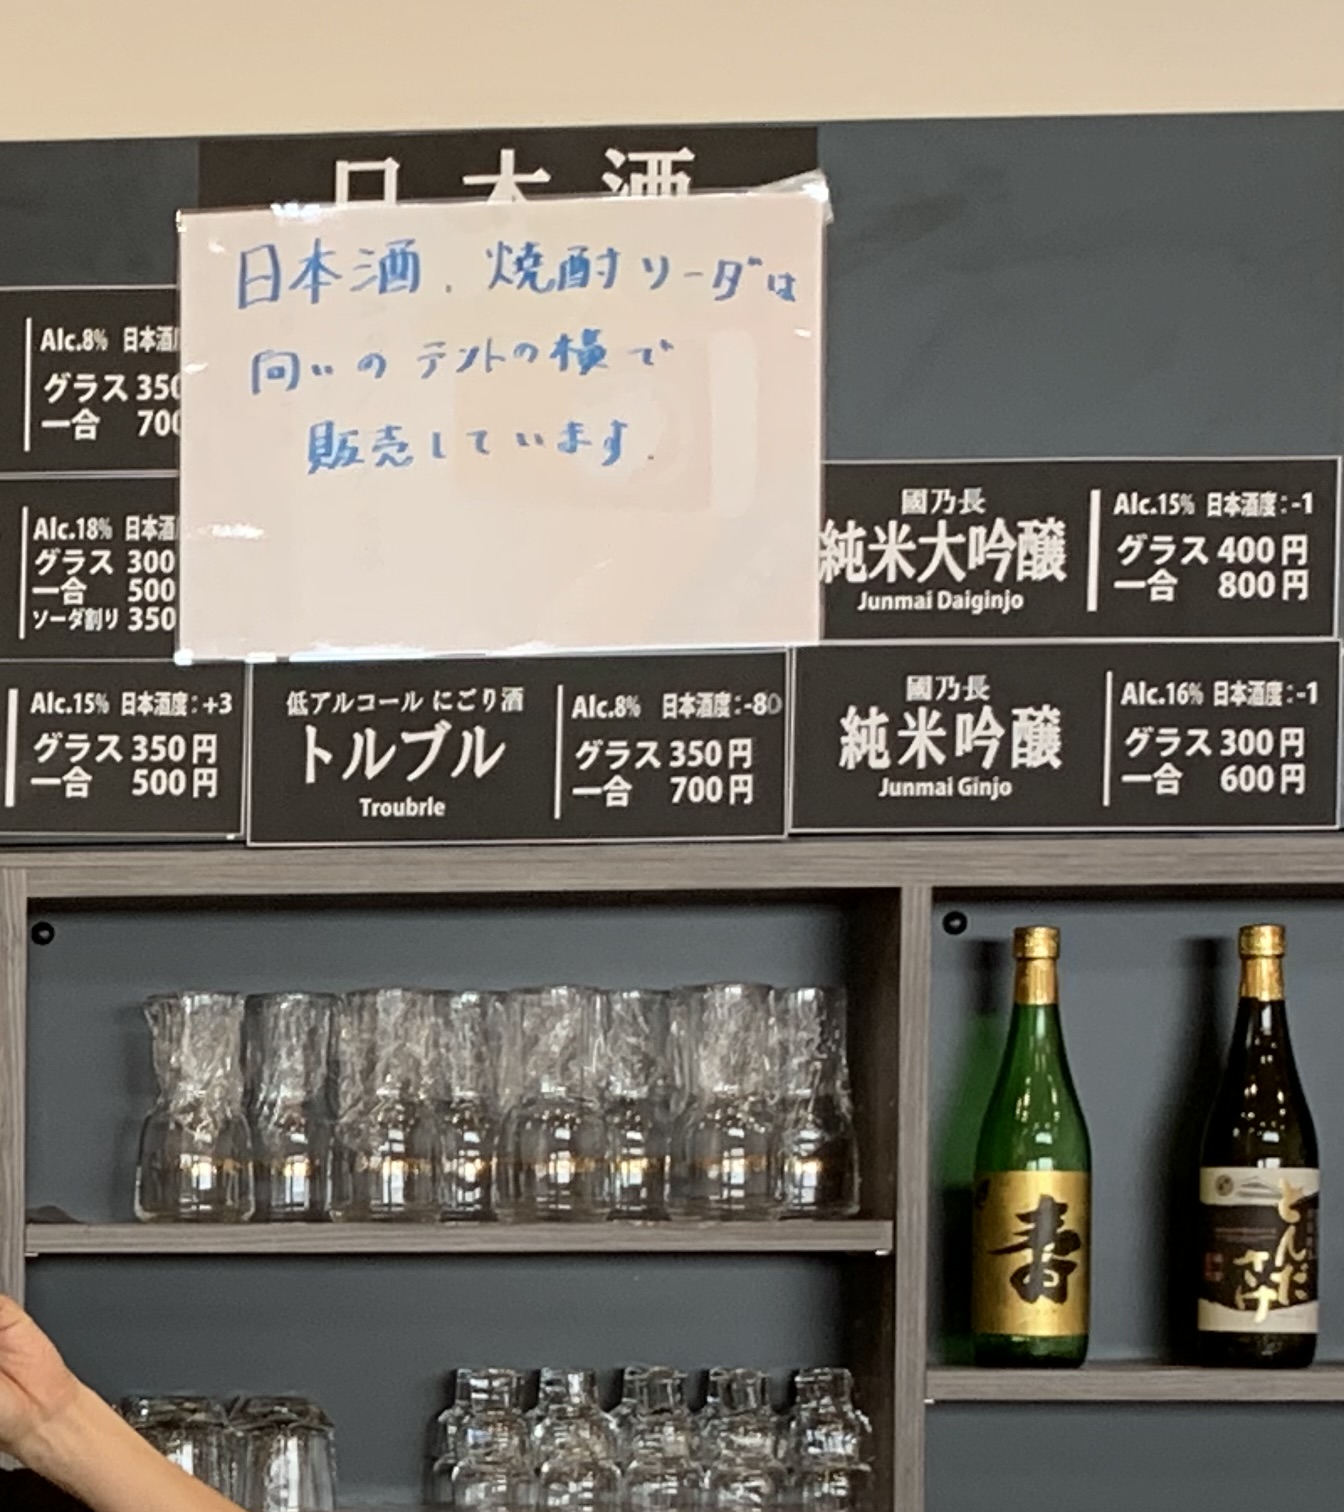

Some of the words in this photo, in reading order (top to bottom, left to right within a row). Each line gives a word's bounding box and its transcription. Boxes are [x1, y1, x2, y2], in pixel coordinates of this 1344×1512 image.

[40, 328, 108, 351] Alc.8%
[124, 326, 178, 352] 日本酒
[44, 372, 128, 403] グラス
[42, 408, 100, 440] 一合
[1114, 492, 1194, 515] Alc.15%
[33, 517, 112, 540] Alc.18%
[126, 515, 177, 541] 日本酒
[35, 548, 113, 575] グラス
[1118, 534, 1208, 565] グラス
[32, 576, 87, 605] 一合
[1114, 569, 1178, 601] 一合
[858, 590, 932, 610] Junmai
[938, 590, 1023, 614] Daiginjo
[33, 608, 118, 631] ソーダ割り
[31, 691, 109, 714] Alc.15%
[287, 691, 423, 715] 低アルコール
[433, 687, 523, 712] にごり酒
[572, 695, 640, 718] Alc.8%
[1121, 681, 1203, 705] Alc.16%
[34, 732, 123, 763] グラス
[306, 720, 505, 783] トルブル
[576, 739, 661, 770] グラス
[1125, 726, 1212, 757] グラス
[31, 766, 92, 798] 一合
[573, 775, 632, 807] 一合
[879, 777, 953, 796] Junmai
[958, 776, 1012, 800] Ginjo
[1122, 763, 1182, 794] 一合
[360, 797, 445, 816] Troubrle
